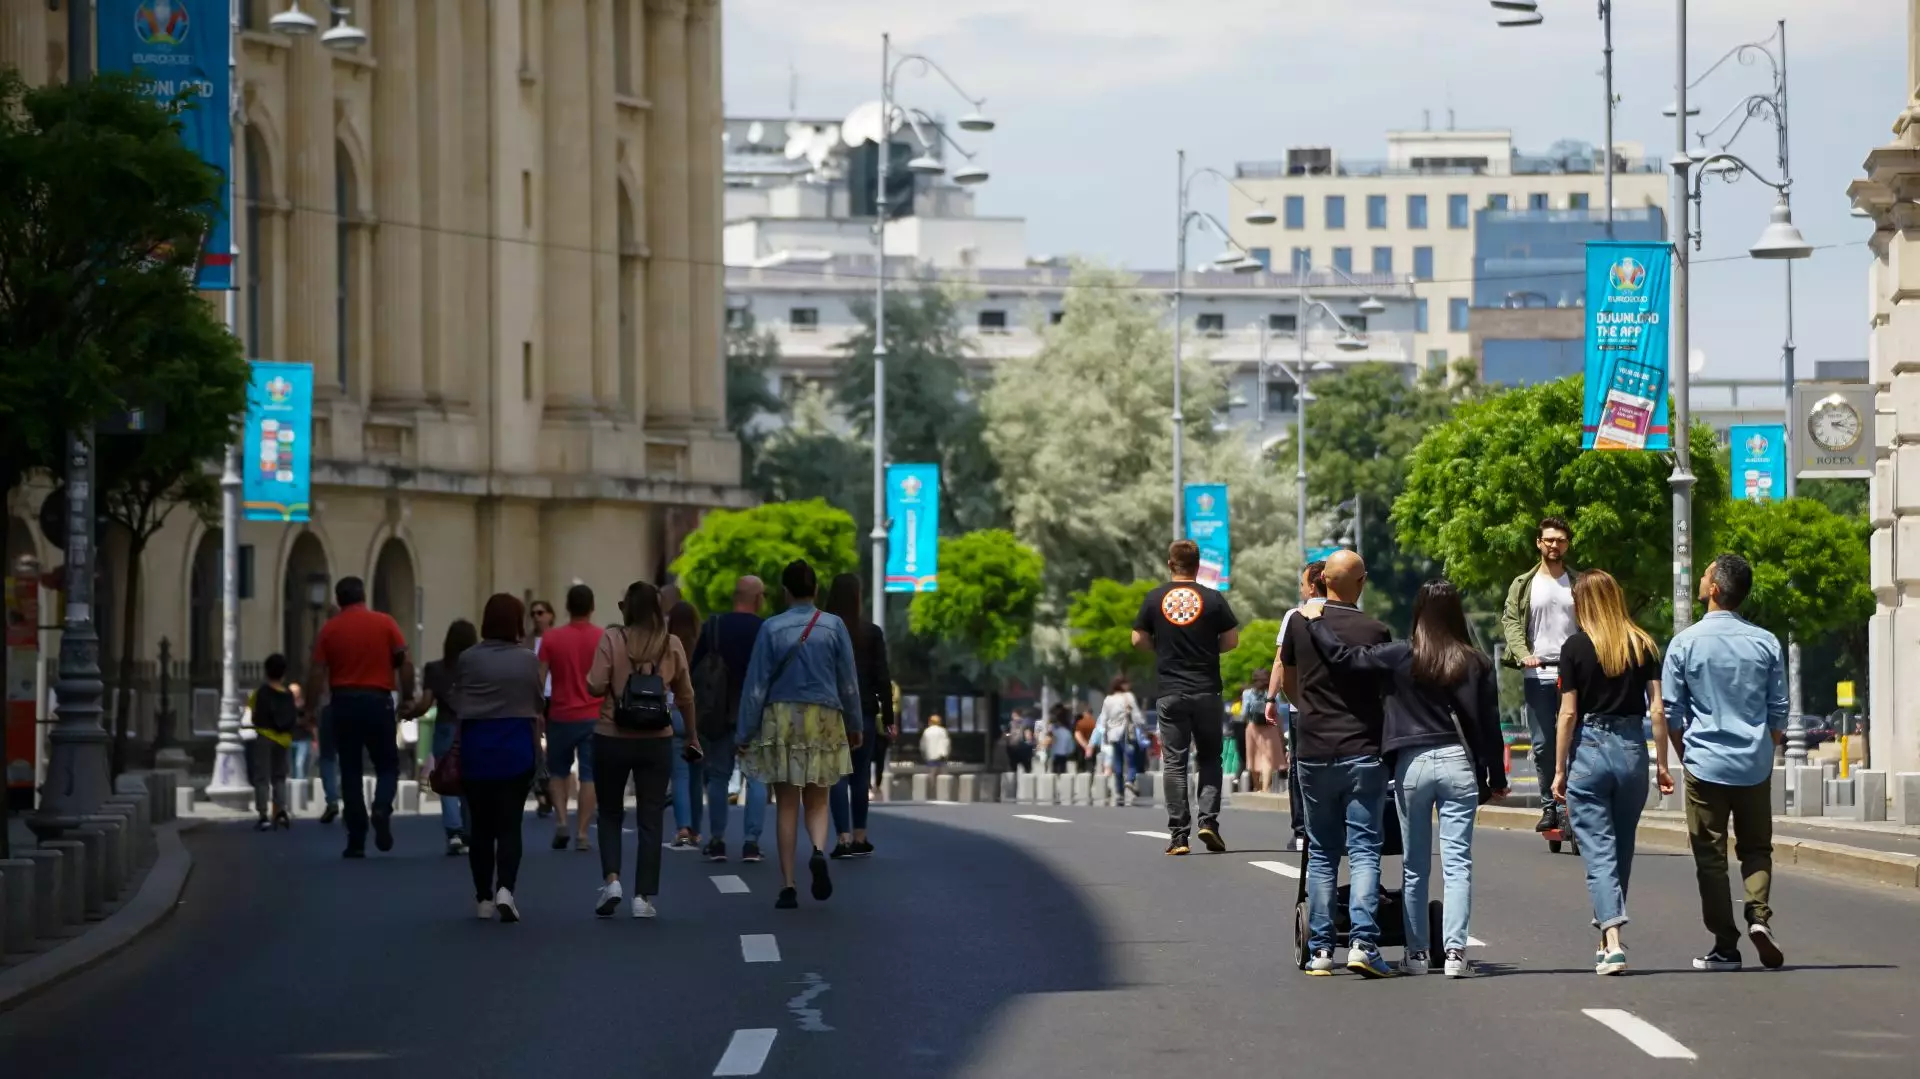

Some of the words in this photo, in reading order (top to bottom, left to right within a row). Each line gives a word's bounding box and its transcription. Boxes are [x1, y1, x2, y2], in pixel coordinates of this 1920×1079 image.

[1596, 312, 1660, 324] DOWNLOAD
[1596, 325, 1617, 337] THE
[1620, 325, 1642, 338] APP
[1816, 456, 1854, 465] ROLEX
